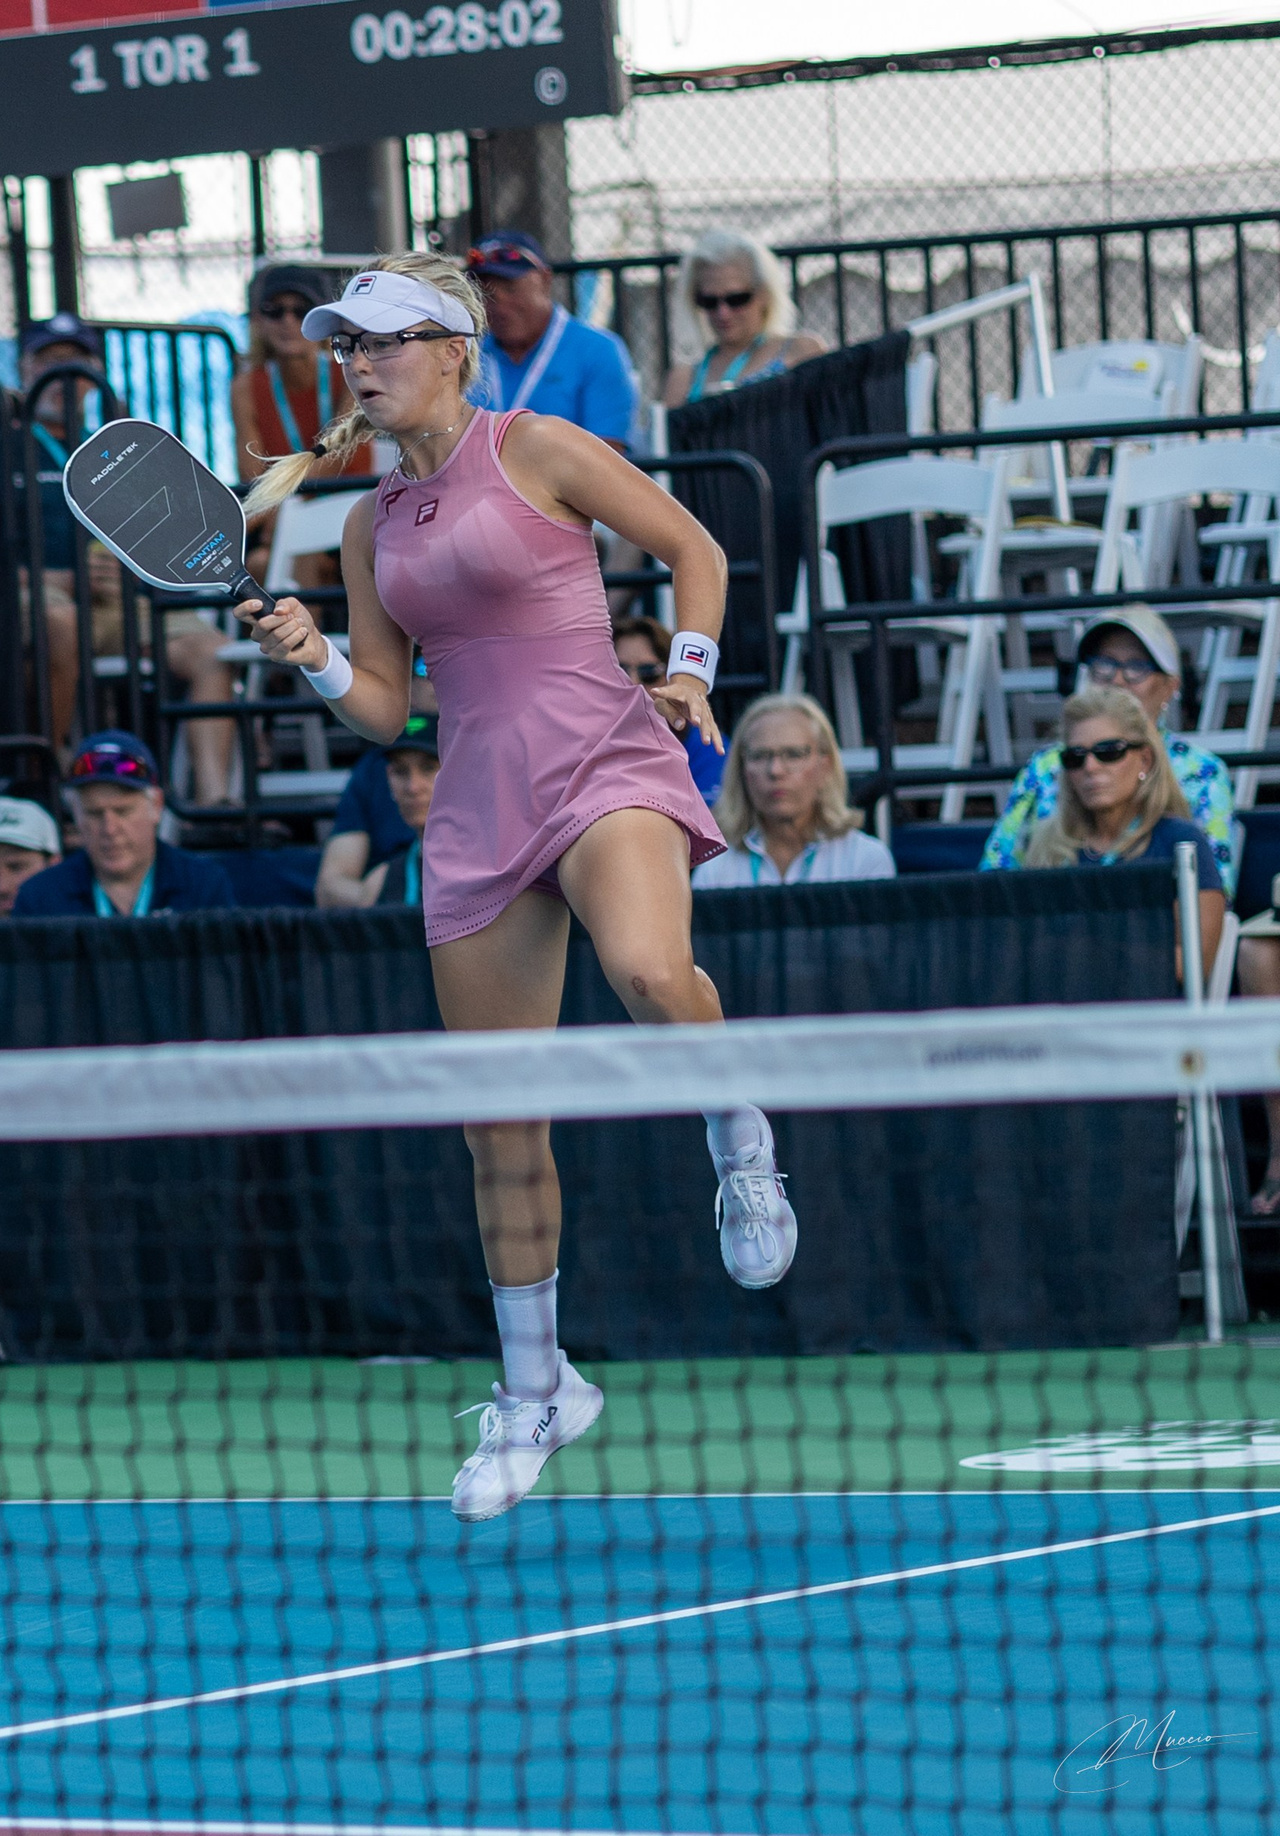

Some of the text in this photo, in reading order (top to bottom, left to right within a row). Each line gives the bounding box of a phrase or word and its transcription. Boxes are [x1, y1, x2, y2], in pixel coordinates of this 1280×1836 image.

[69, 43, 107, 94] 1
[113, 33, 211, 90] TOR
[222, 27, 261, 77] 1
[350, 0, 565, 64] 00:28:02
[90, 441, 139, 486] PADDLETEK
[184, 532, 226, 569] BANTAM
[531, 1405, 559, 1445] FILA
